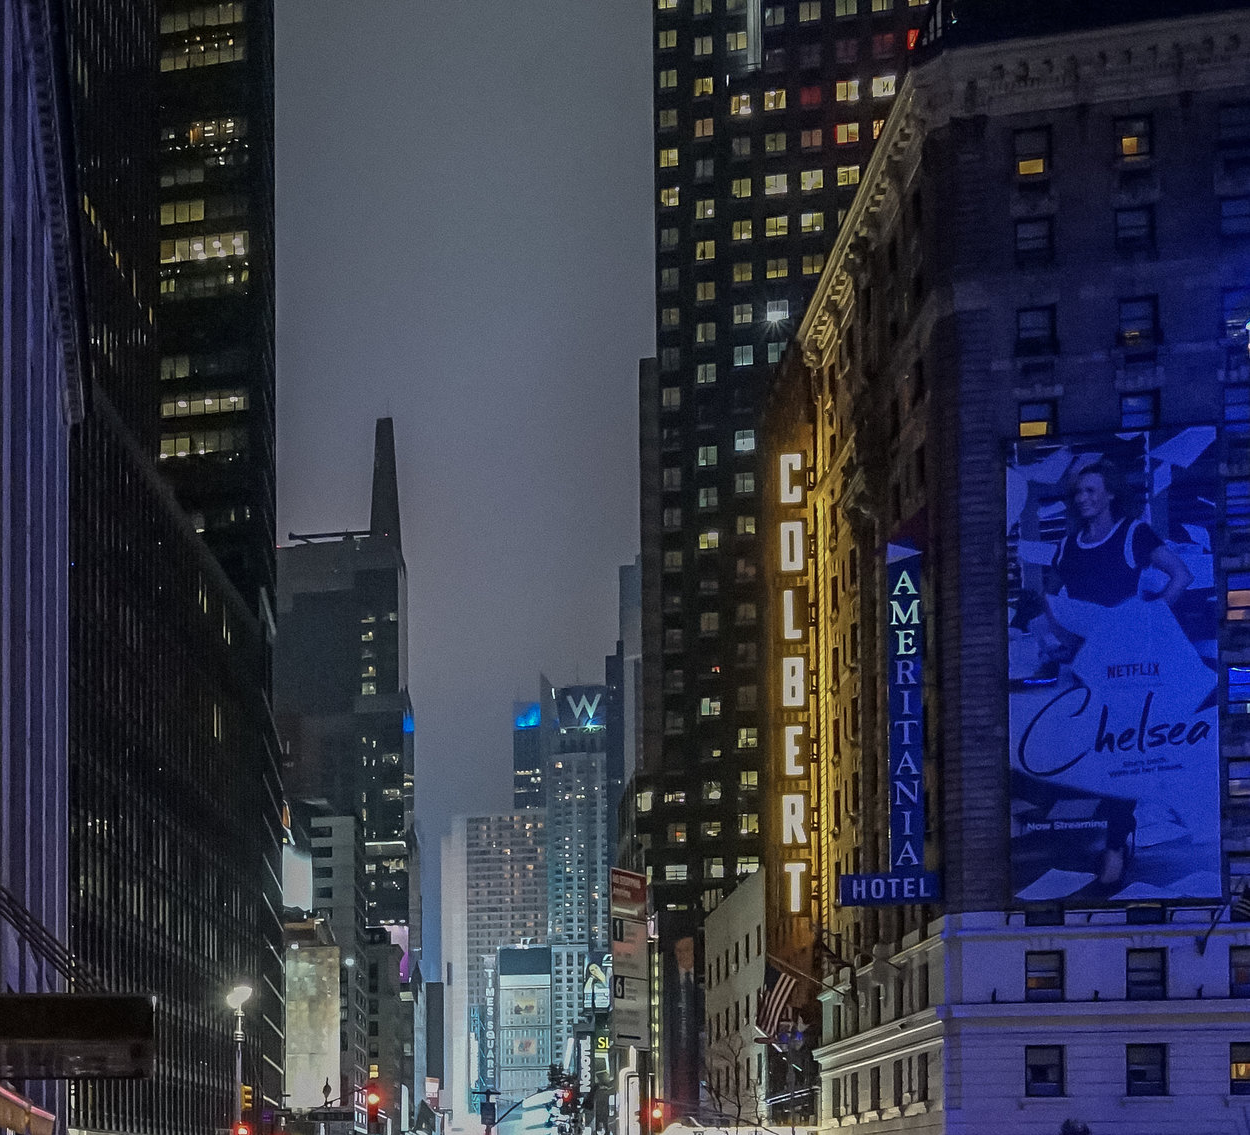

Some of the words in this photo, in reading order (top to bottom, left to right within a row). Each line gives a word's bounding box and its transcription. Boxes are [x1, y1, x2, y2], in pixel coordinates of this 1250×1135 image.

[780, 453, 806, 912] COLBERT
[1107, 663, 1160, 679] NETFLIX
[566, 693, 602, 720] W
[890, 569, 921, 866] AMERITANIA
[1018, 685, 1211, 778] Chelsea
[1027, 821, 1050, 831] Now
[1053, 819, 1108, 831] Streaming
[852, 877, 931, 900] HOTEL
[484, 968, 496, 1016] TIMES
[485, 1020, 496, 1078] SQUARE
[579, 1035, 591, 1093] NOVOTEL
